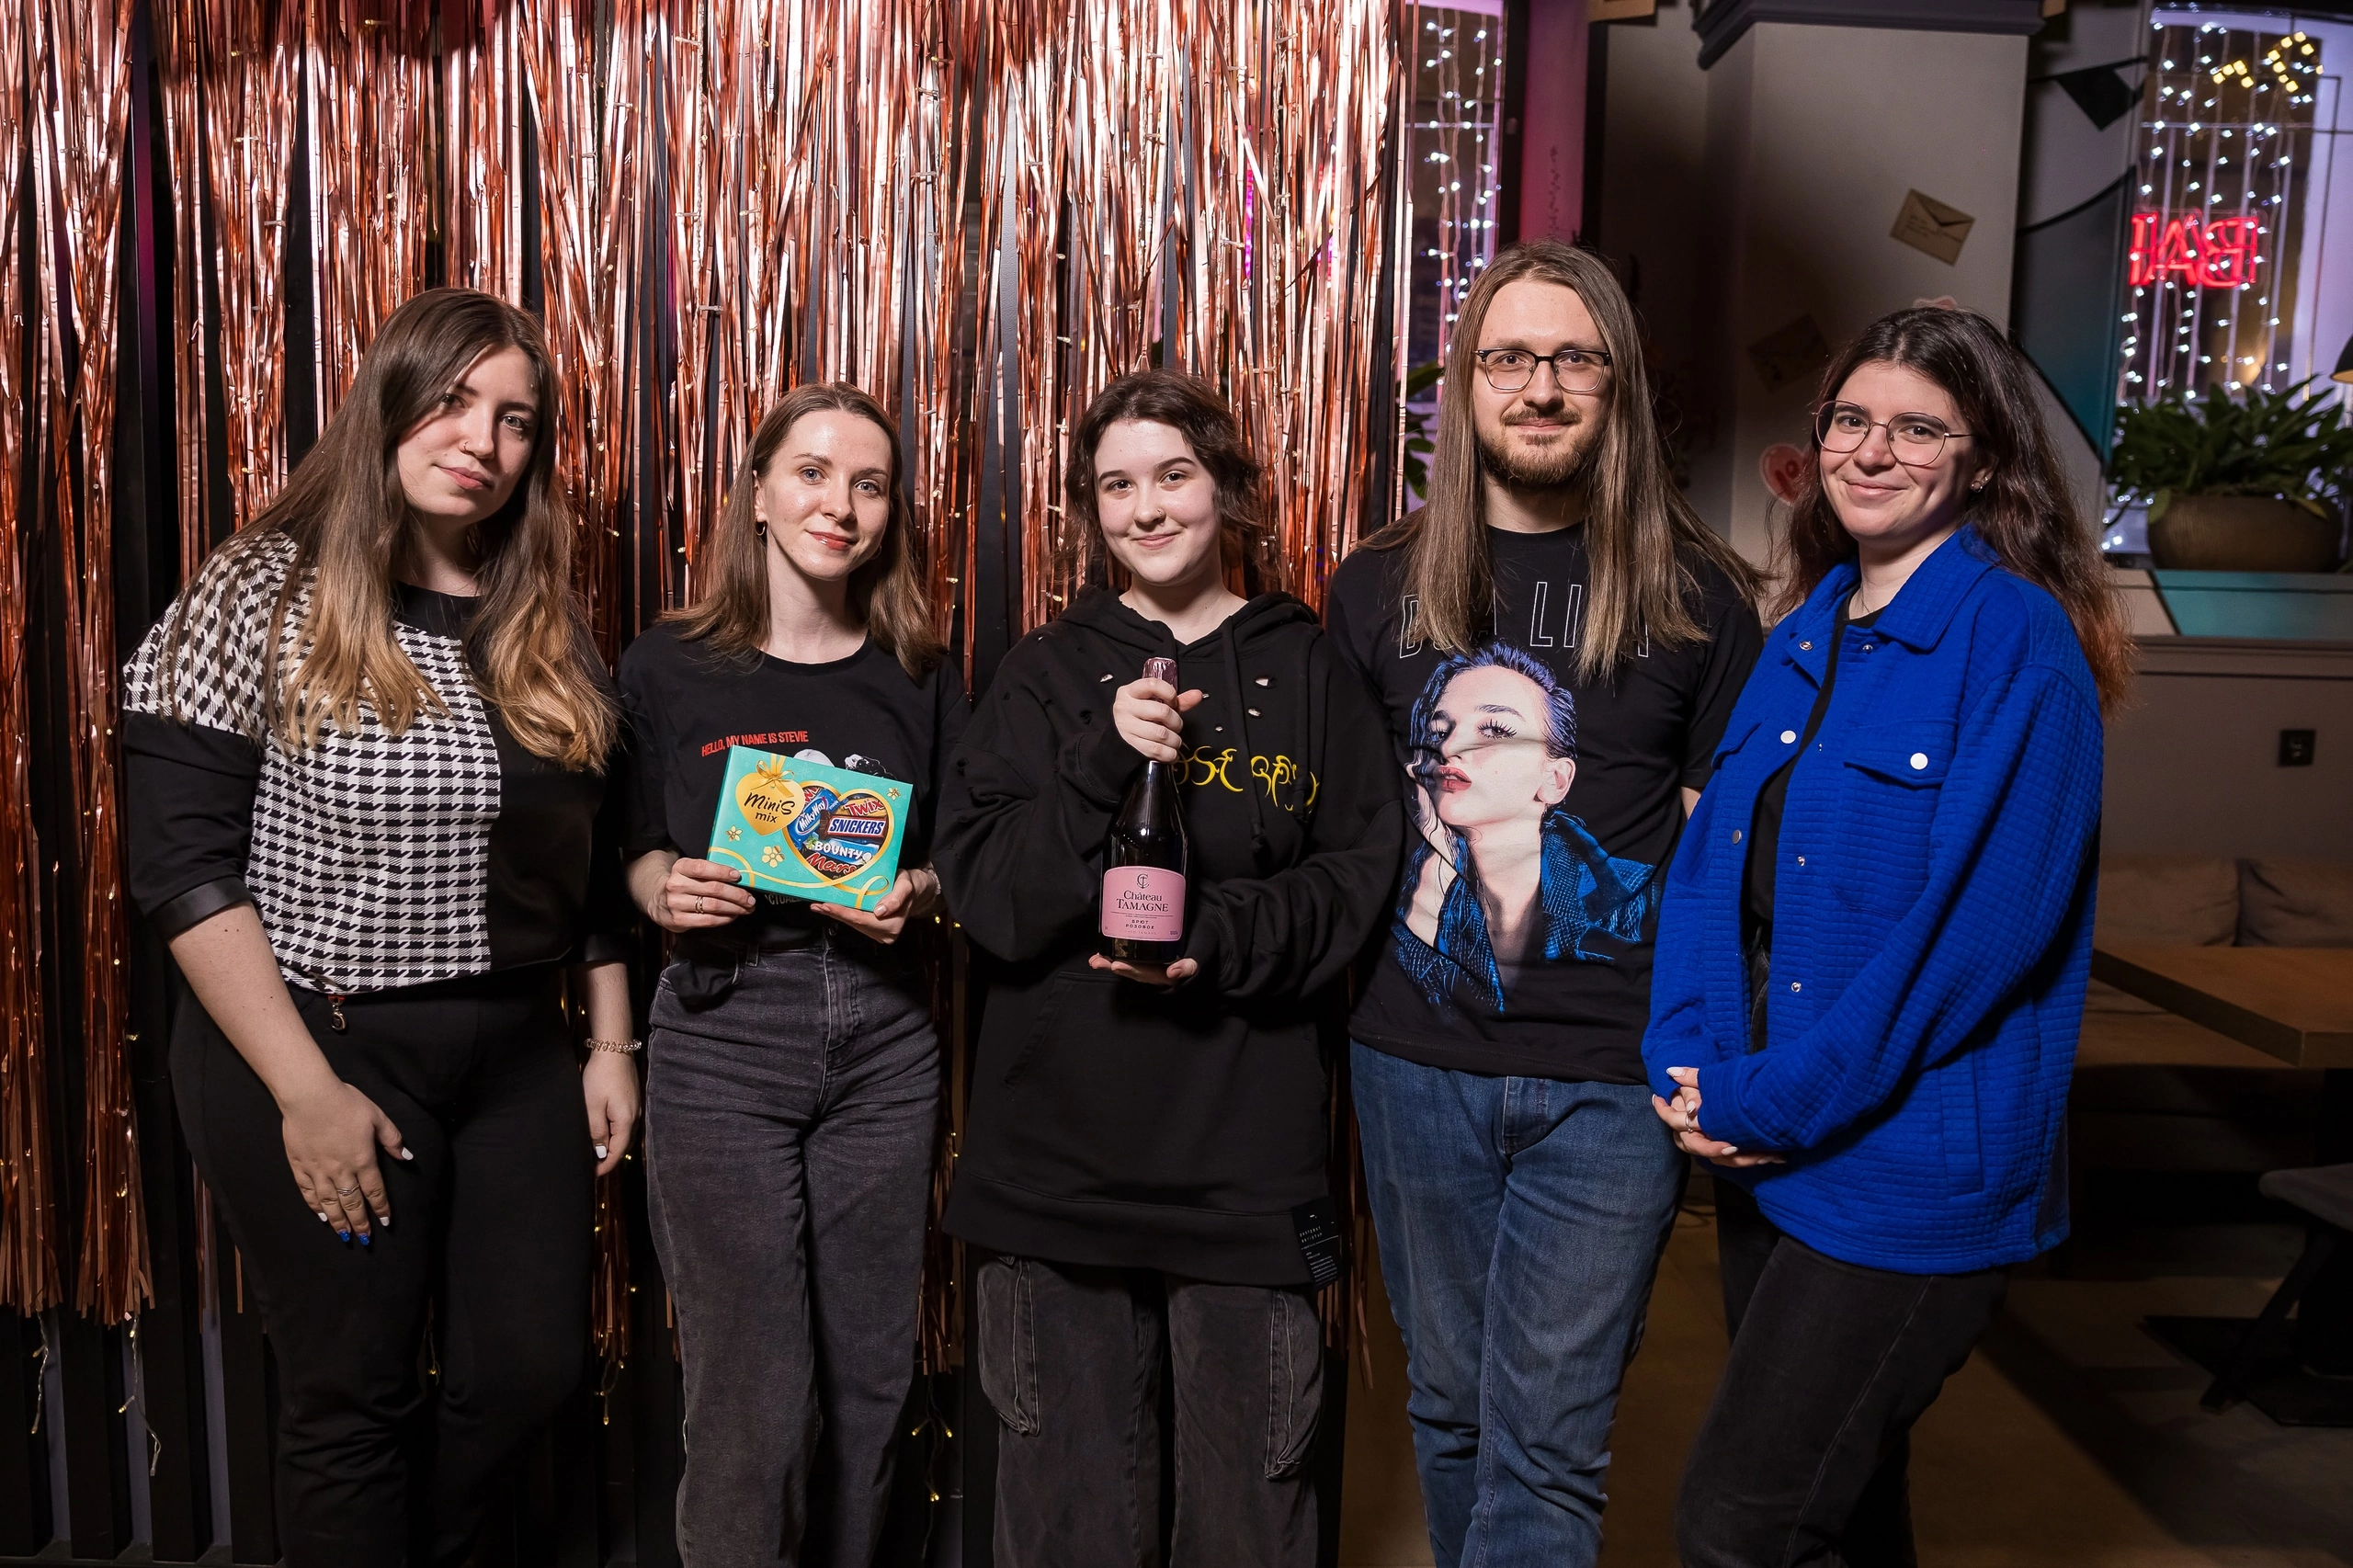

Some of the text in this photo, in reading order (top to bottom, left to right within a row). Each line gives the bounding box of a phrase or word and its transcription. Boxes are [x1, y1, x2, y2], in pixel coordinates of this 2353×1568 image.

[701, 731, 809, 757] HELLO, MY NAME IS STEVIE
[755, 812, 779, 824] mix
[829, 818, 885, 835] SNICKERS
[814, 841, 863, 860] BOUNTY
[806, 853, 858, 875] Mars
[1123, 890, 1163, 902] Château
[1116, 898, 1169, 912] TAMAGNE
